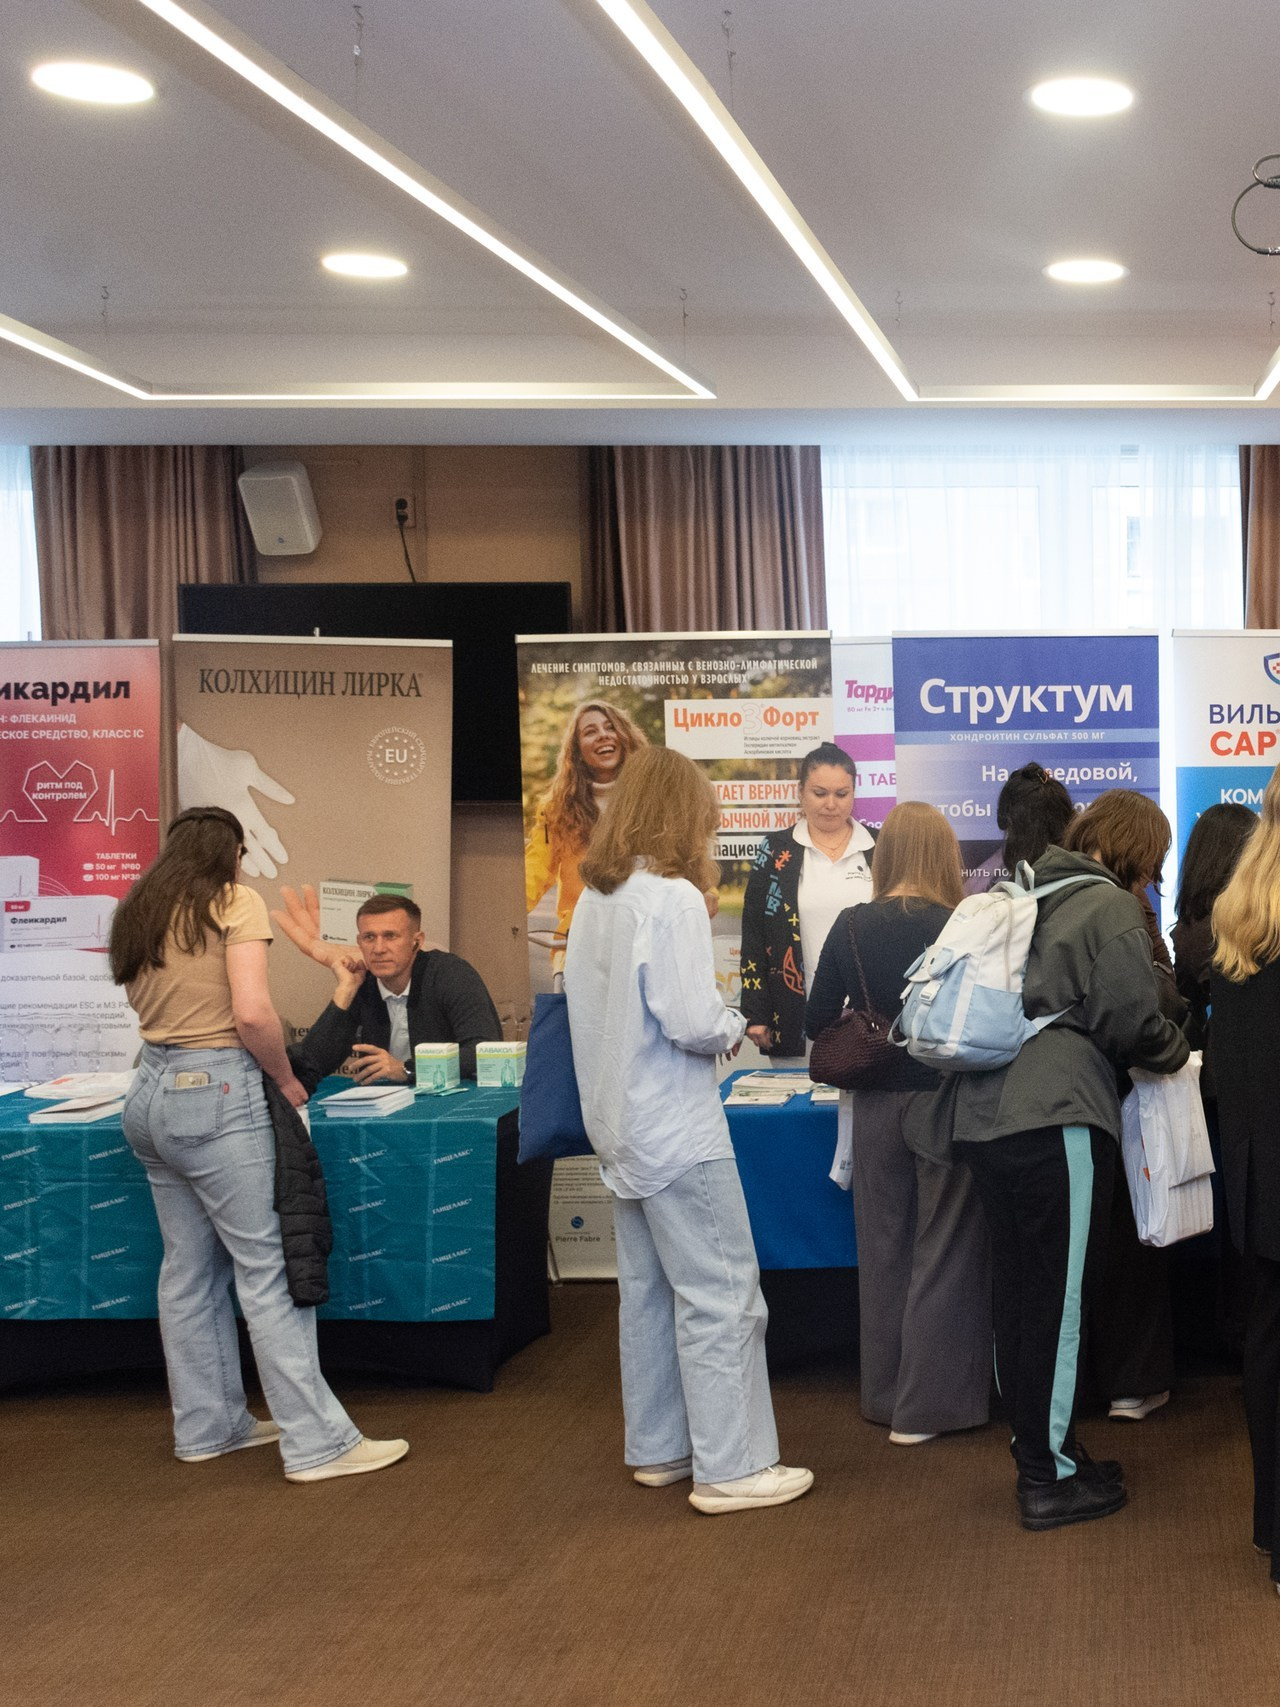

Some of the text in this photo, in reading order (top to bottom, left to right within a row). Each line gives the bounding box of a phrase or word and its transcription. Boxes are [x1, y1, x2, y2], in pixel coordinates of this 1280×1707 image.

[531, 657, 818, 674] ЛЕЧЕНИЕ СИМПТОМОВ, СВЯЗАННЫХ С ВЕНОЗНО-ЛИМФАТИЧЕСКОЙ
[199, 669, 335, 699] КОЛХИЦИН
[598, 674, 689, 686] НЕДОСТАТОЧНОСТЬЮ
[692, 674, 698, 684] У
[920, 678, 1133, 724] Структум
[10, 714, 76, 724] ФЛЕКАИНИД
[674, 708, 742, 732] Цикло
[763, 706, 819, 731] Форт
[31, 730, 91, 741] СРЕДСТВО,
[93, 729, 131, 739] КЛАСС
[950, 731, 1105, 742] ХОНДРОИТИН СУЛЬФАТ 500 МГ
[1210, 731, 1277, 756] САР
[385, 749, 408, 763] EU
[982, 765, 1008, 782] На
[36, 782, 83, 791] ритм под
[32, 792, 87, 801] контролем
[938, 800, 991, 817] тобы
